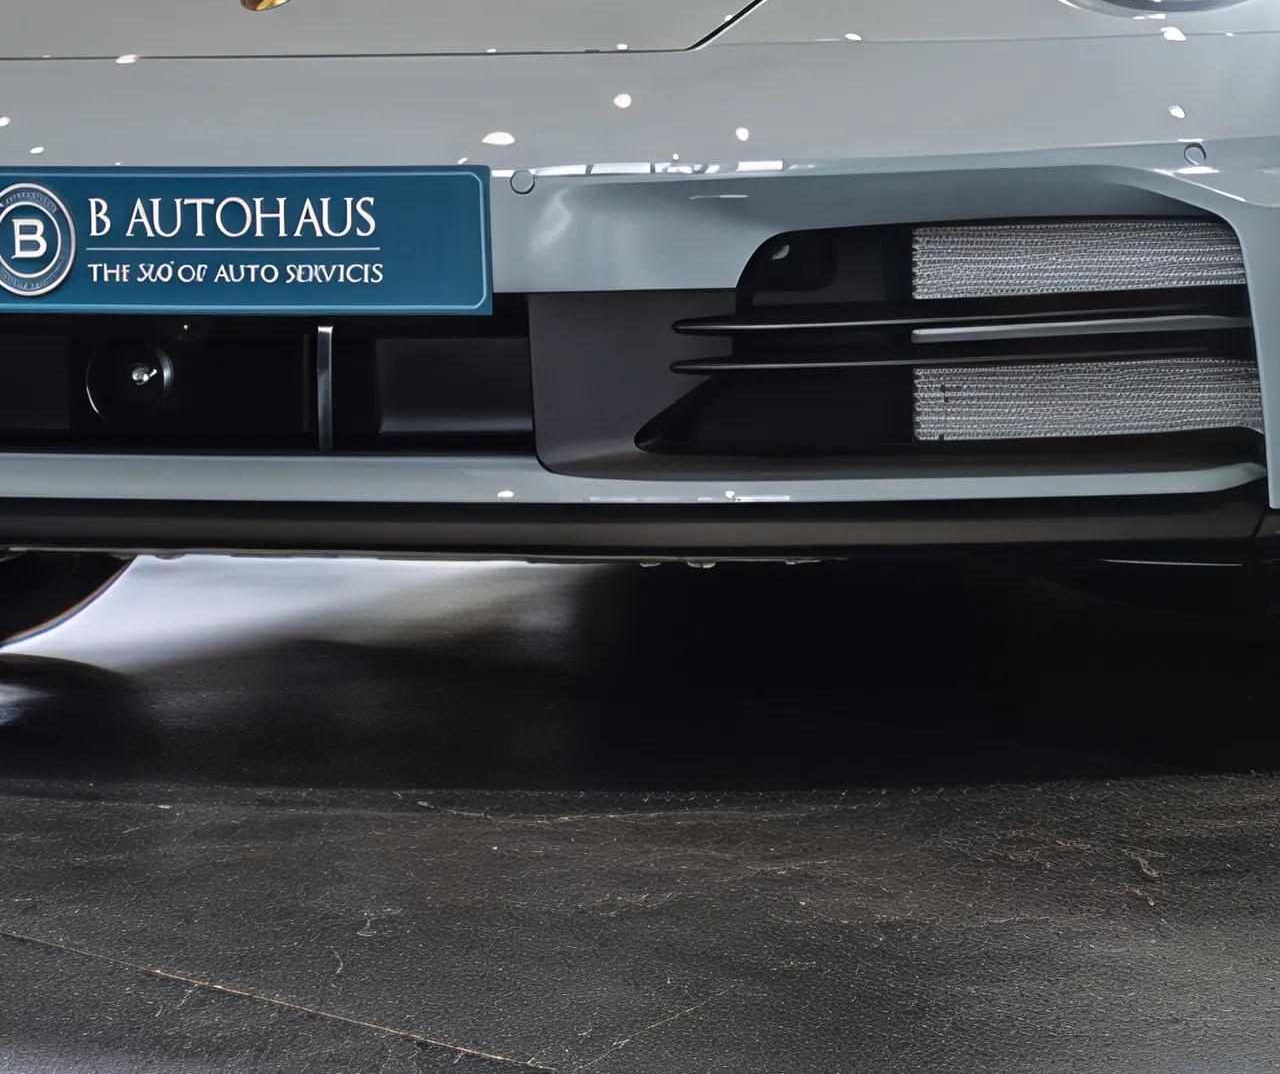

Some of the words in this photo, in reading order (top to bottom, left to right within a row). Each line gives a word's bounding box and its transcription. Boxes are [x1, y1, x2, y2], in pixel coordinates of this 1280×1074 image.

[87, 197, 111, 237] B
[125, 196, 376, 238] AUTOHAUS
[10, 218, 48, 259] B
[213, 263, 280, 284] AUTO
